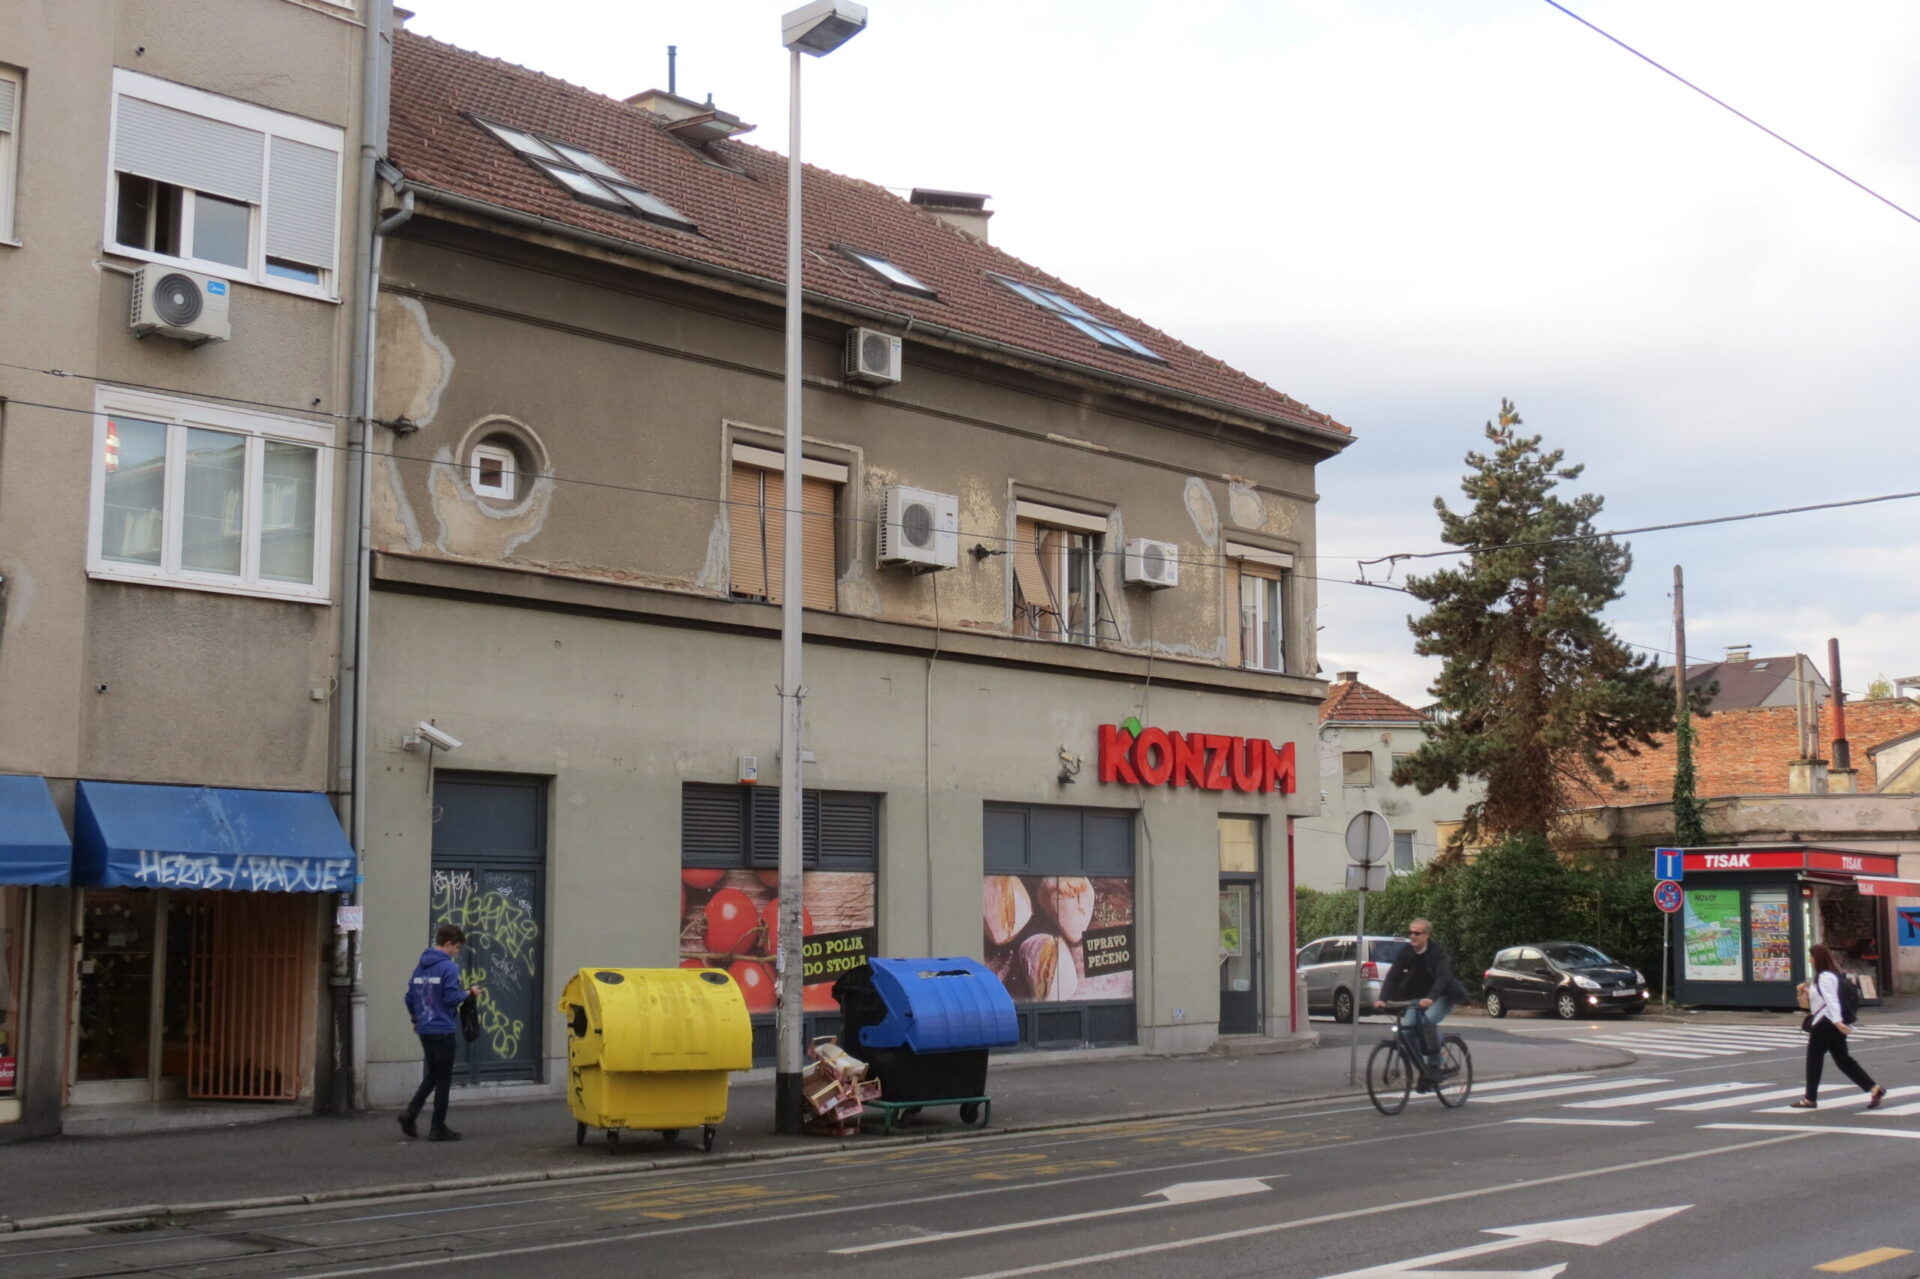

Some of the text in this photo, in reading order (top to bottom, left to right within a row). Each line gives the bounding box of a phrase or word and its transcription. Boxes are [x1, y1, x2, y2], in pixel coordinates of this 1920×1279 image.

[1098, 724, 1296, 794] KONZUM
[1704, 853, 1751, 868] TISAK
[1842, 856, 1863, 870] TISAK
[803, 942, 822, 957] OD
[825, 937, 864, 952] POLJA
[1086, 934, 1127, 951] UPRAVO
[804, 954, 867, 976] DO STOLA
[1088, 950, 1130, 969] PEČENO
